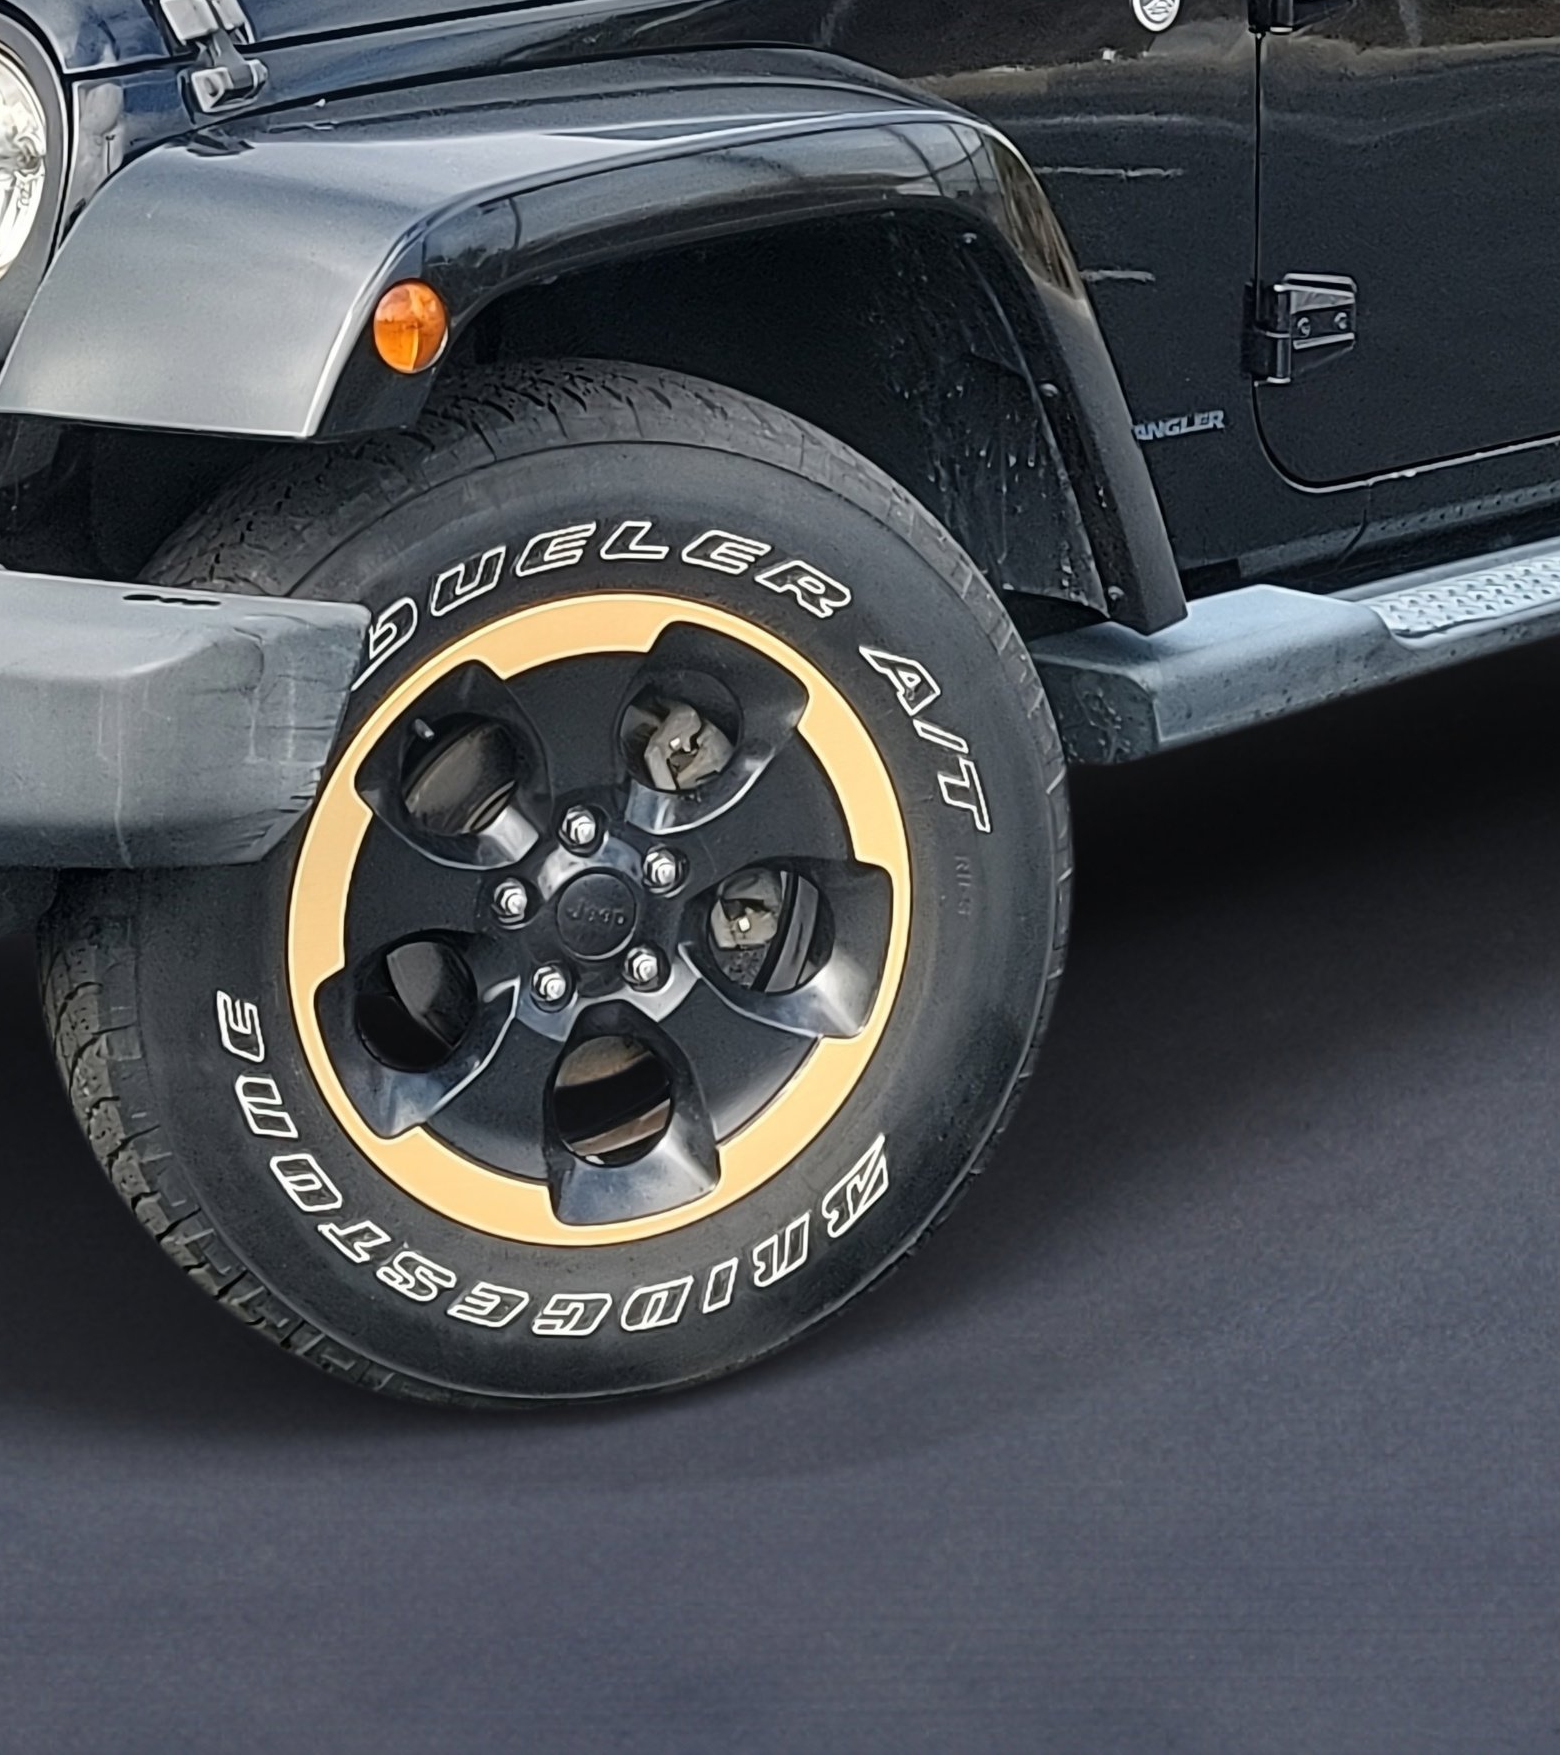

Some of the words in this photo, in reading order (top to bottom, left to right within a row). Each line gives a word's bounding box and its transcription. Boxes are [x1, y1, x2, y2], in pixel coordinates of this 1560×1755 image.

[1132, 409, 1225, 441] ANGLER
[350, 520, 852, 692] DUELER
[858, 645, 991, 834] A/T
[216, 989, 891, 1337] BRIDGESTONE
